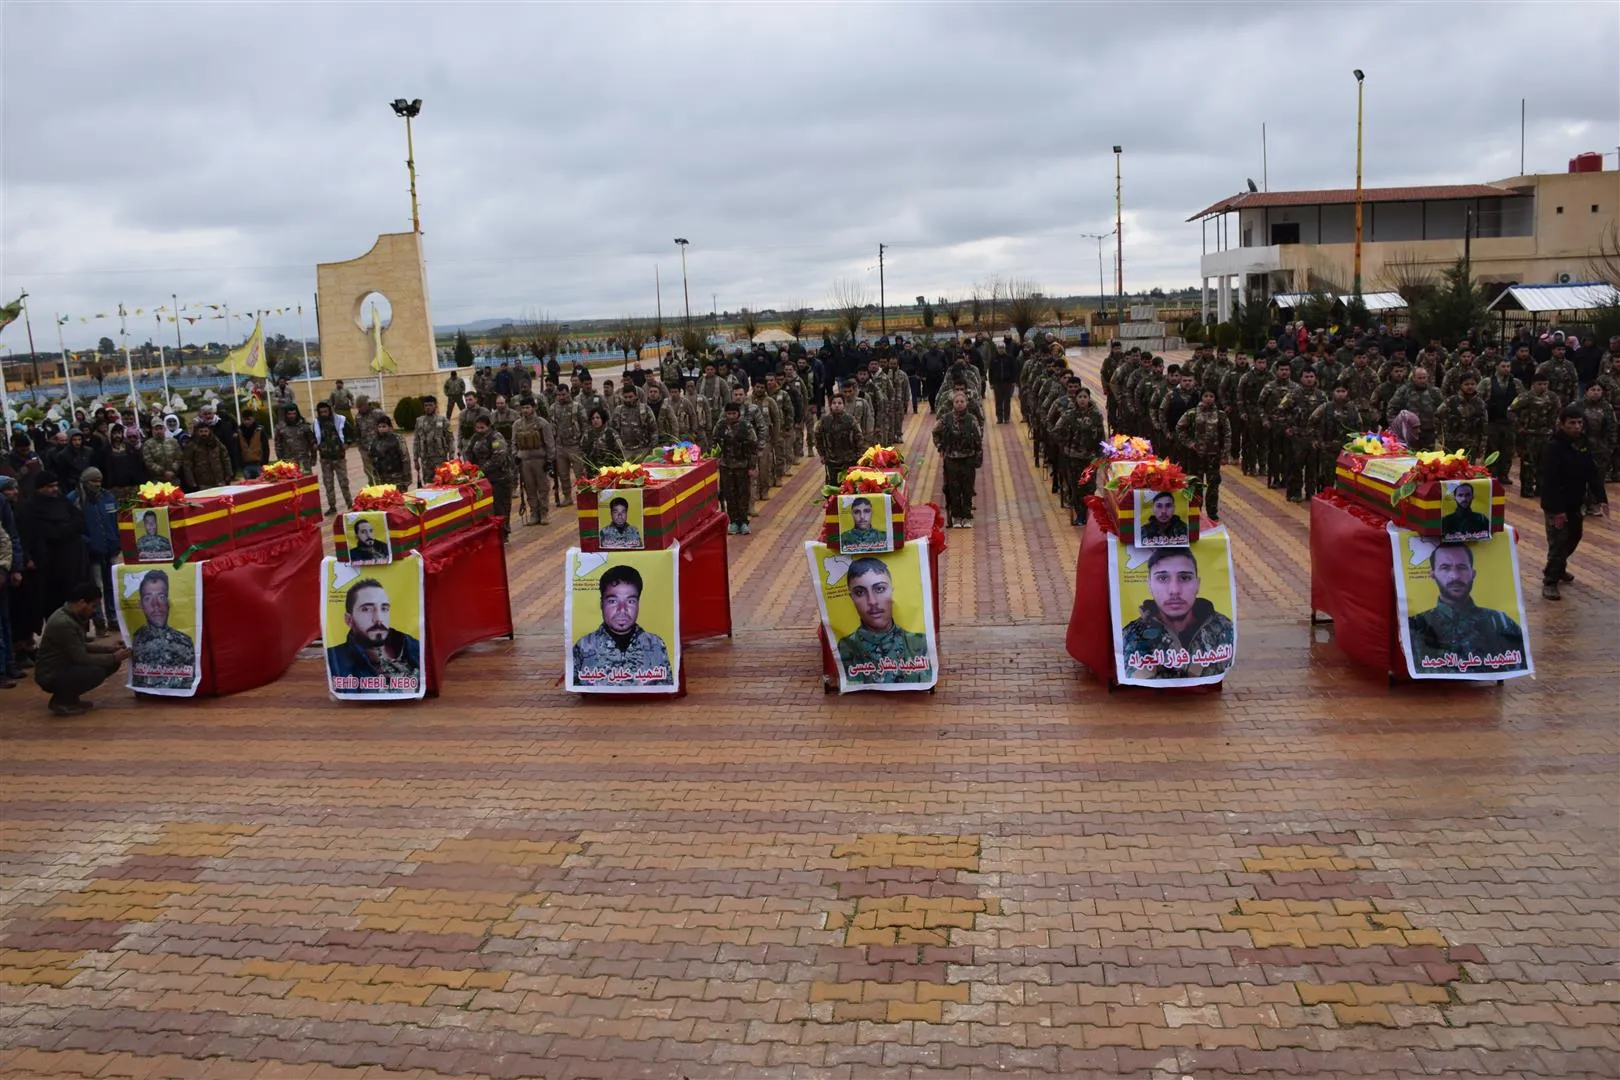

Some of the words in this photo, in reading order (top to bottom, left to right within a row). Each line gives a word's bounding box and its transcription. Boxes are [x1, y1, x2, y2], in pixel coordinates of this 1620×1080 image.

[1129, 650, 1164, 669] الجراد
[1166, 647, 1189, 669] فواز
[1193, 645, 1232, 666] الشهيد
[1422, 653, 1457, 667] الاحمد
[1458, 653, 1482, 672] علي
[1484, 650, 1521, 668] الشهيد
[849, 662, 875, 676] عيسى
[877, 657, 898, 674] بشار
[899, 657, 928, 673] الشهيد
[579, 667, 606, 681] خليف
[608, 667, 632, 681] خليل
[635, 667, 666, 681] الشهيد
[390, 676, 418, 690] NEBO
